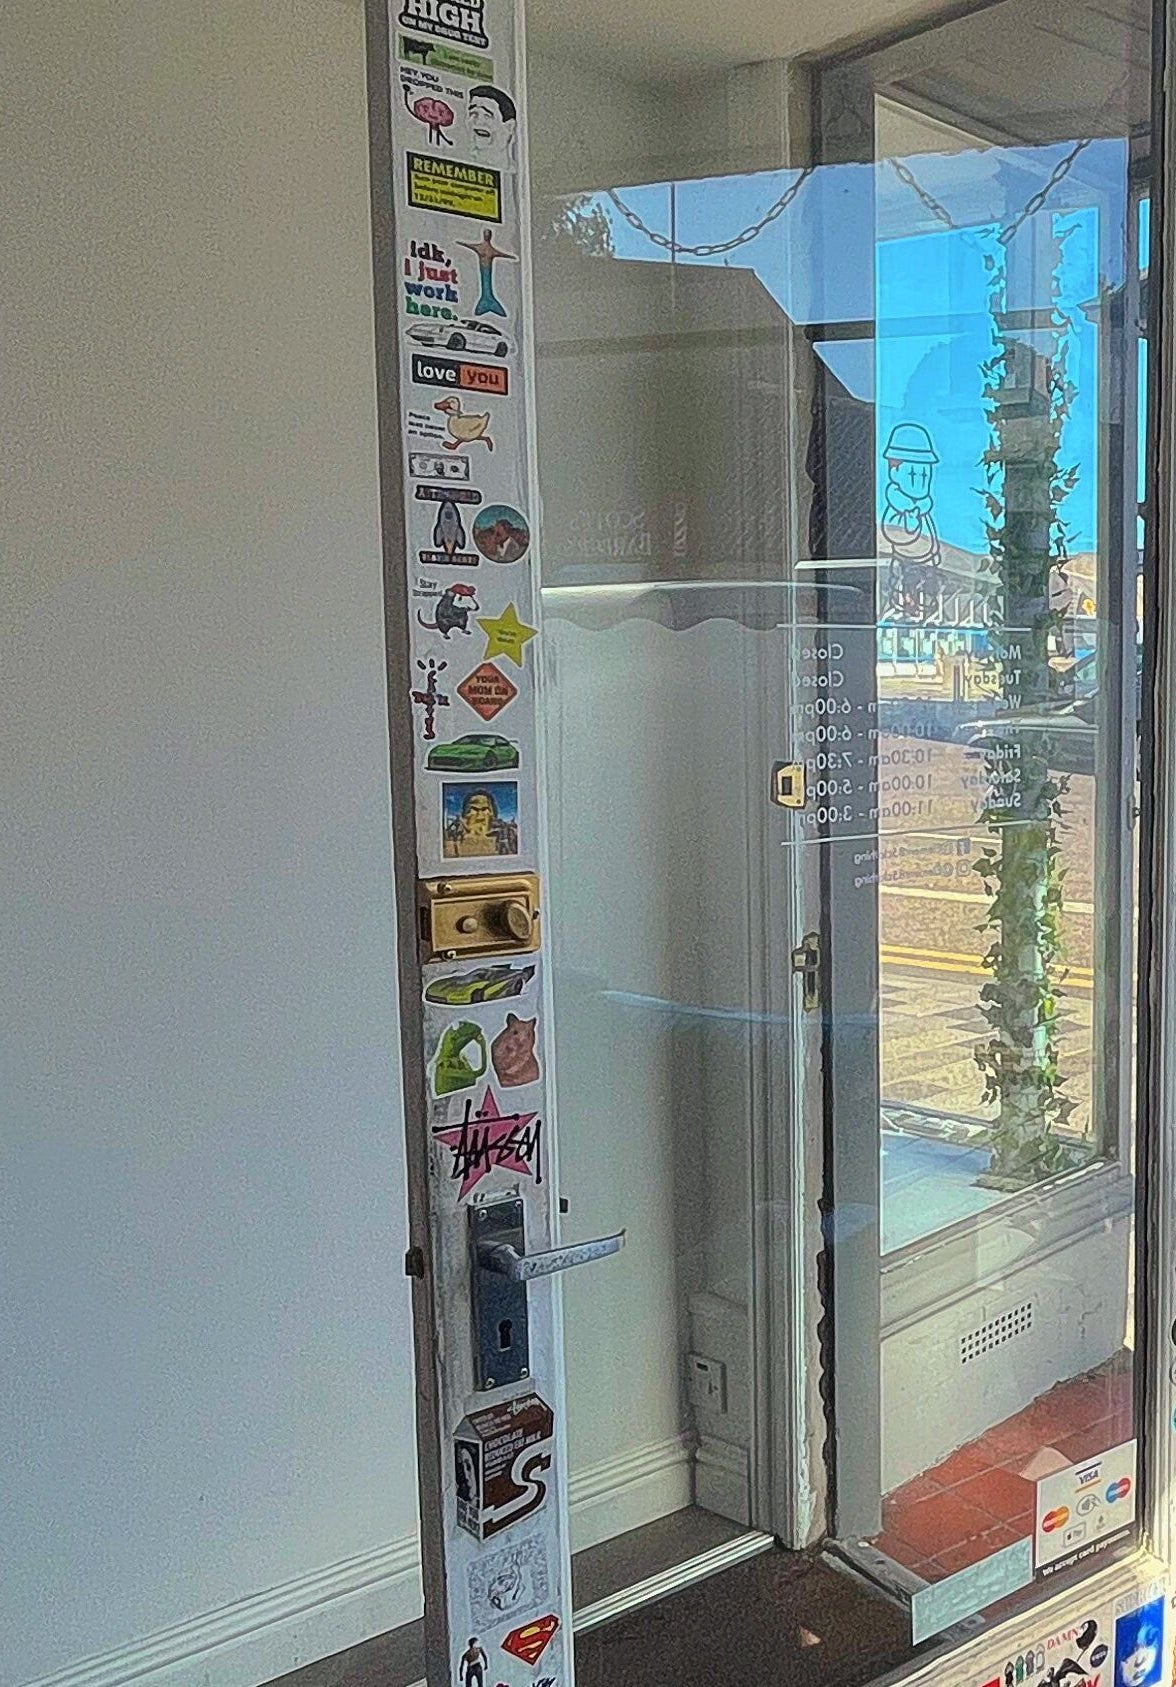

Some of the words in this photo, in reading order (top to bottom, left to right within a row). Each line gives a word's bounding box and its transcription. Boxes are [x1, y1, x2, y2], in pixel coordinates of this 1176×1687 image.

[408, 0, 481, 34] HIGH
[420, 71, 439, 82] YOU
[445, 87, 463, 99] THIS
[413, 157, 494, 187] REMEMBER
[418, 261, 458, 284] just
[404, 282, 458, 303] work
[417, 360, 457, 382] love
[467, 369, 499, 386] you
[468, 685, 492, 696] MOM
[1079, 1469, 1099, 1485] VISA
[1078, 1545, 1095, 1560] card
